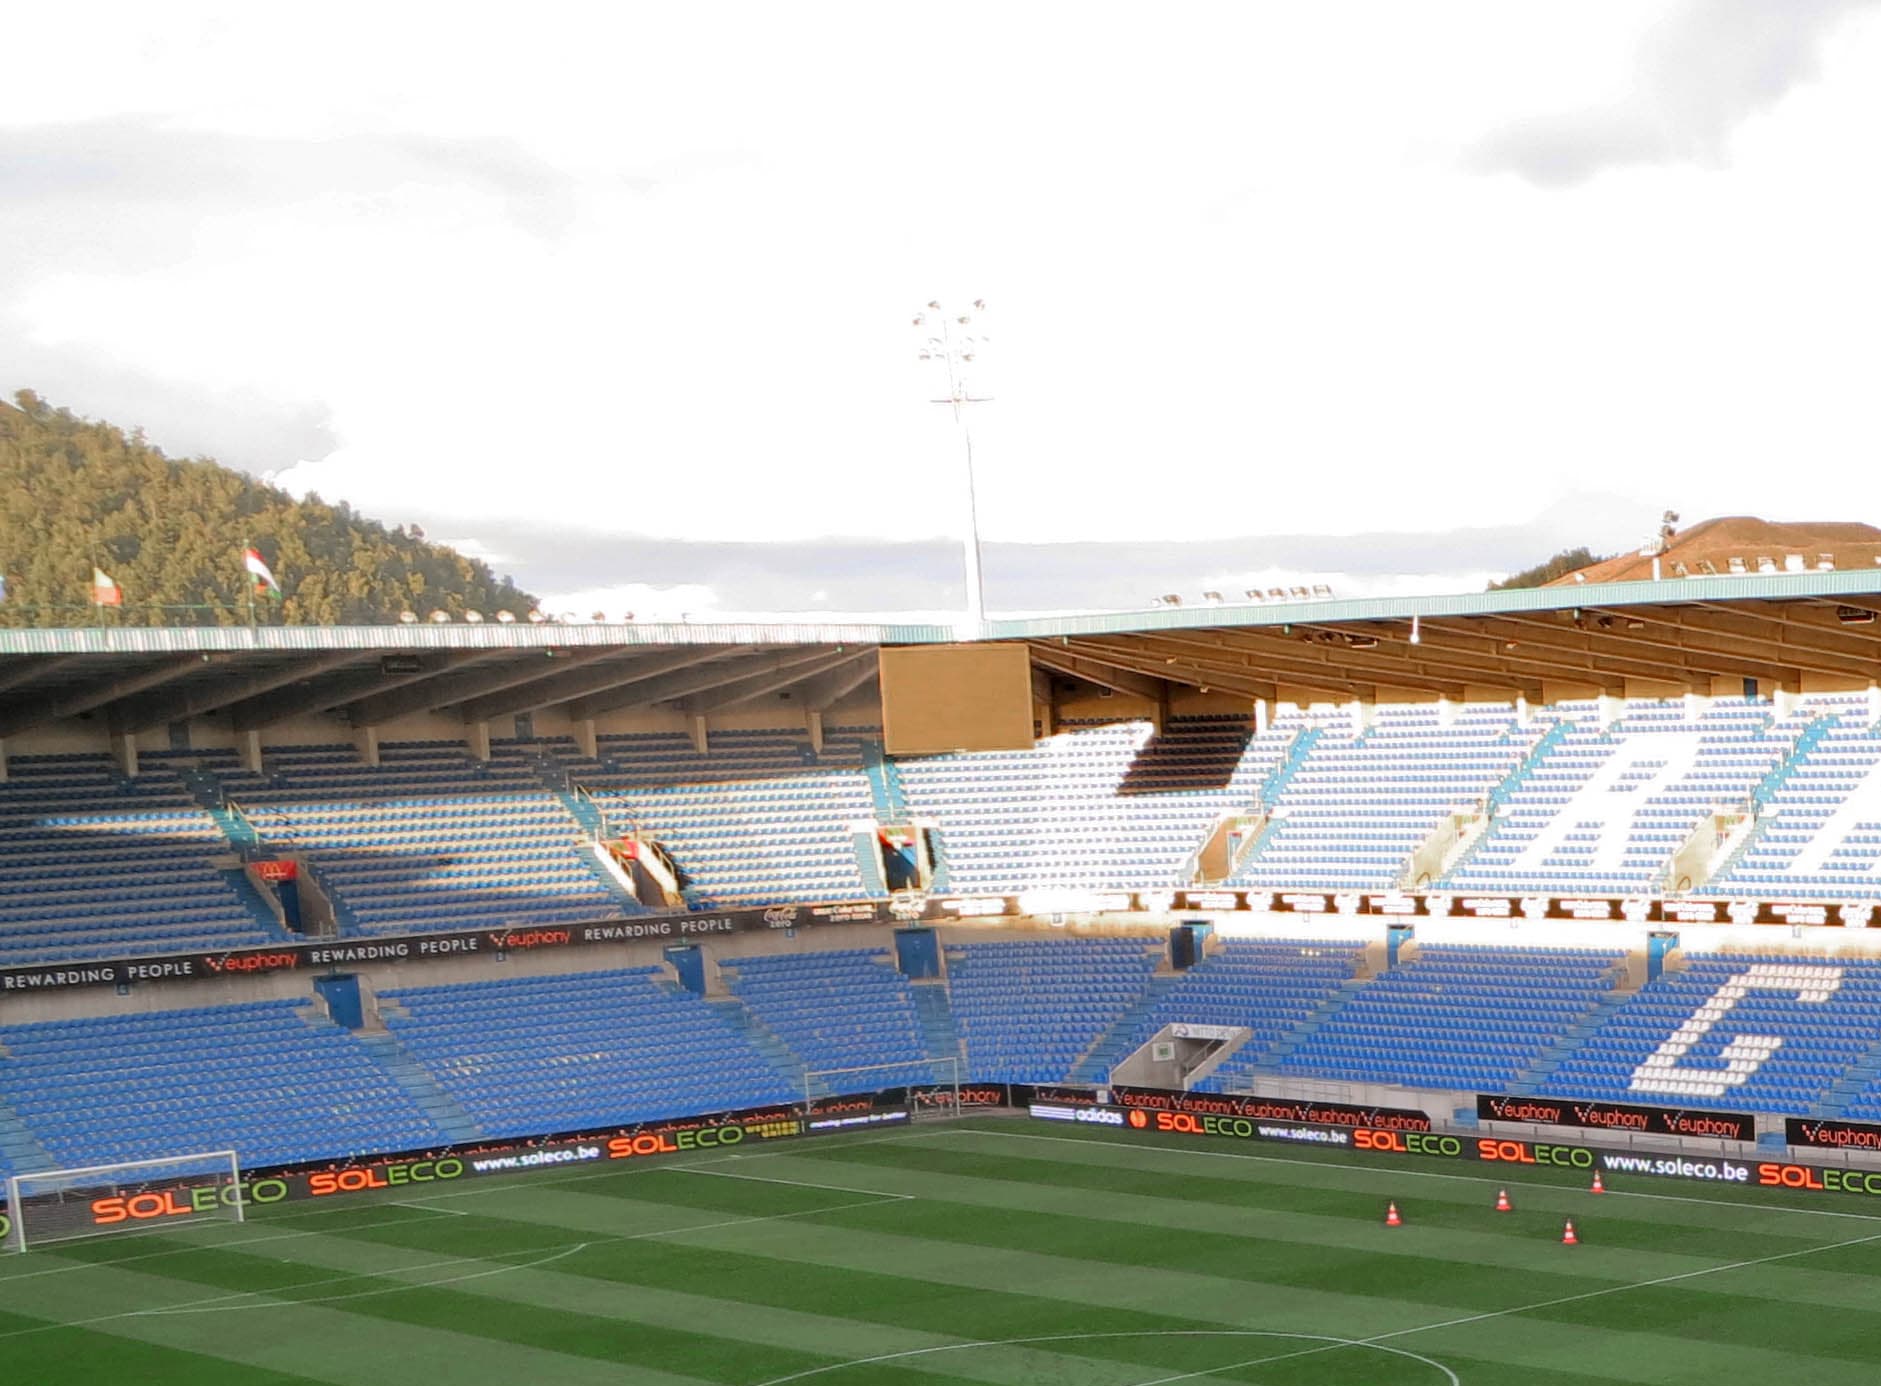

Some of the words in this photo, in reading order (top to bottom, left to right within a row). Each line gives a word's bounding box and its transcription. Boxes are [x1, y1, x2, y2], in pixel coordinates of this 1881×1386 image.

[507, 930, 571, 947] euphony
[585, 923, 671, 941] REWARDING
[681, 919, 732, 933] PEOPLE
[312, 944, 409, 963] REWARDING
[421, 938, 477, 953] PEOPLE
[226, 952, 298, 973] euphony
[5, 968, 115, 989] REWARDING
[128, 962, 193, 979] PEOPLE
[1124, 1093, 1170, 1110] euphony
[1184, 1097, 1232, 1115] euphony
[1246, 1101, 1297, 1120] euphony
[1076, 1106, 1123, 1125] adidas
[1309, 1106, 1361, 1126] euphony
[1375, 1112, 1430, 1131] euphony
[1505, 1103, 1560, 1122] euphony
[1590, 1109, 1648, 1128] euphony
[1158, 1112, 1252, 1138] SOLECO
[1259, 1125, 1347, 1144] www.soleco.be
[1679, 1116, 1740, 1137] euphony
[608, 1126, 743, 1159] SOLECO
[1354, 1130, 1460, 1155] SOLECO
[473, 1145, 599, 1172] www.soleco.be
[1479, 1139, 1592, 1168] SOLECO
[310, 1159, 464, 1195] SOLECO
[1604, 1153, 1748, 1182] www.soleco.be
[91, 1178, 289, 1224] SOLECO
